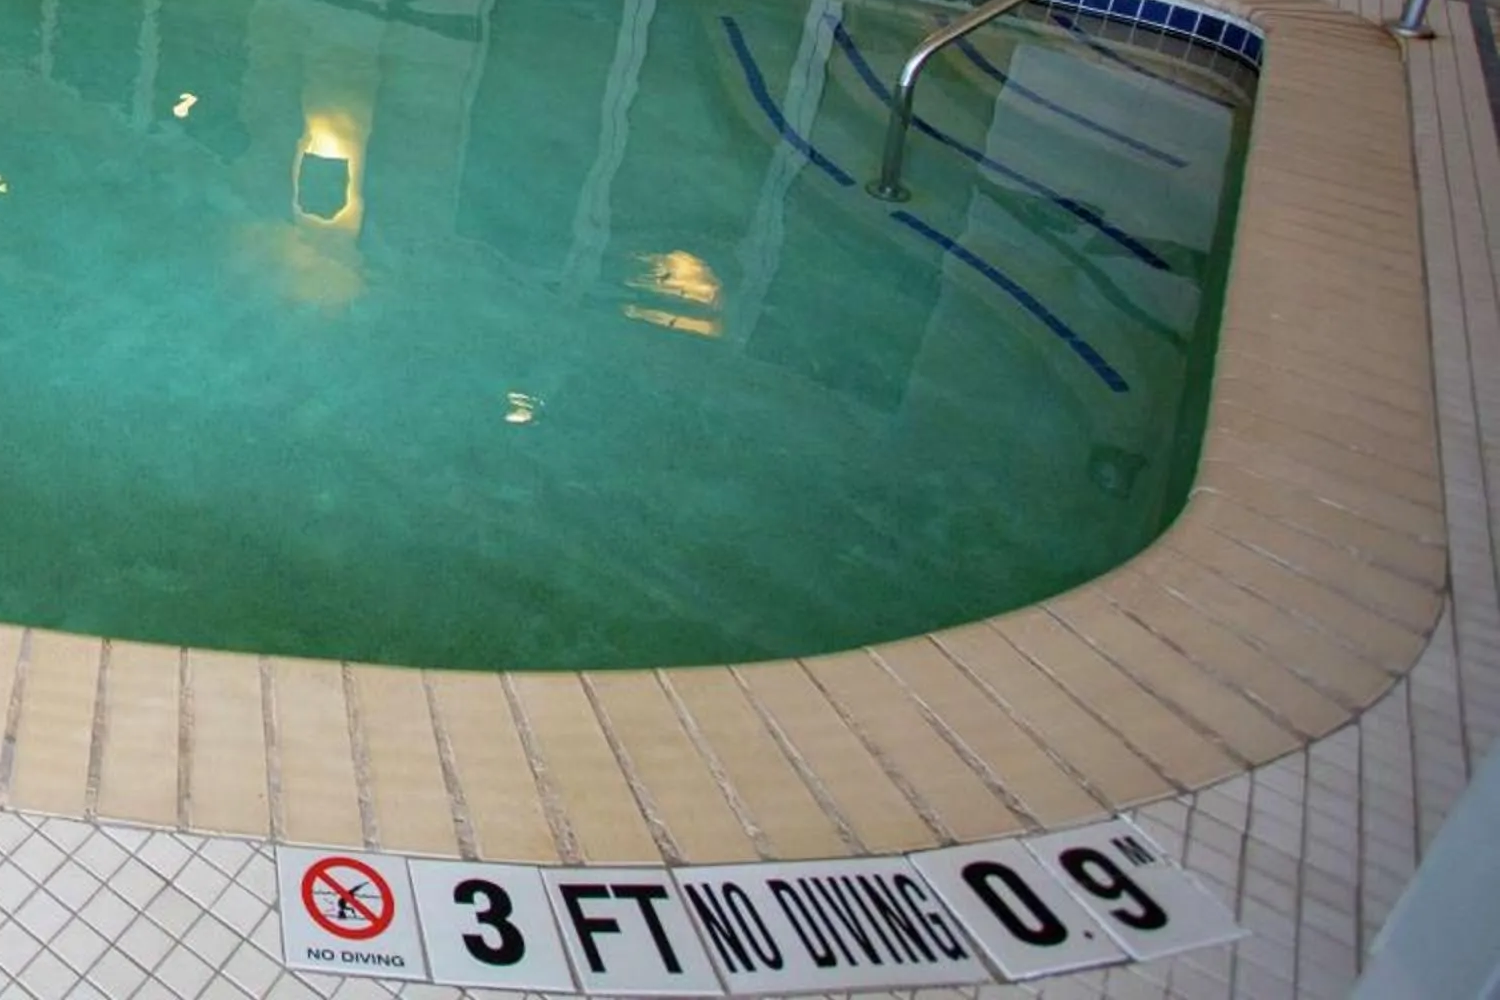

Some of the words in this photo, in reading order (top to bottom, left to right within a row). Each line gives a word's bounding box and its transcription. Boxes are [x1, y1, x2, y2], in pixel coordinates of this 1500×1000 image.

[454, 879, 526, 966] 3
[559, 884, 683, 973] FT
[684, 882, 784, 973] NO
[766, 874, 969, 967] DIVING
[307, 948, 334, 960] NO
[341, 951, 405, 967] DIVING
